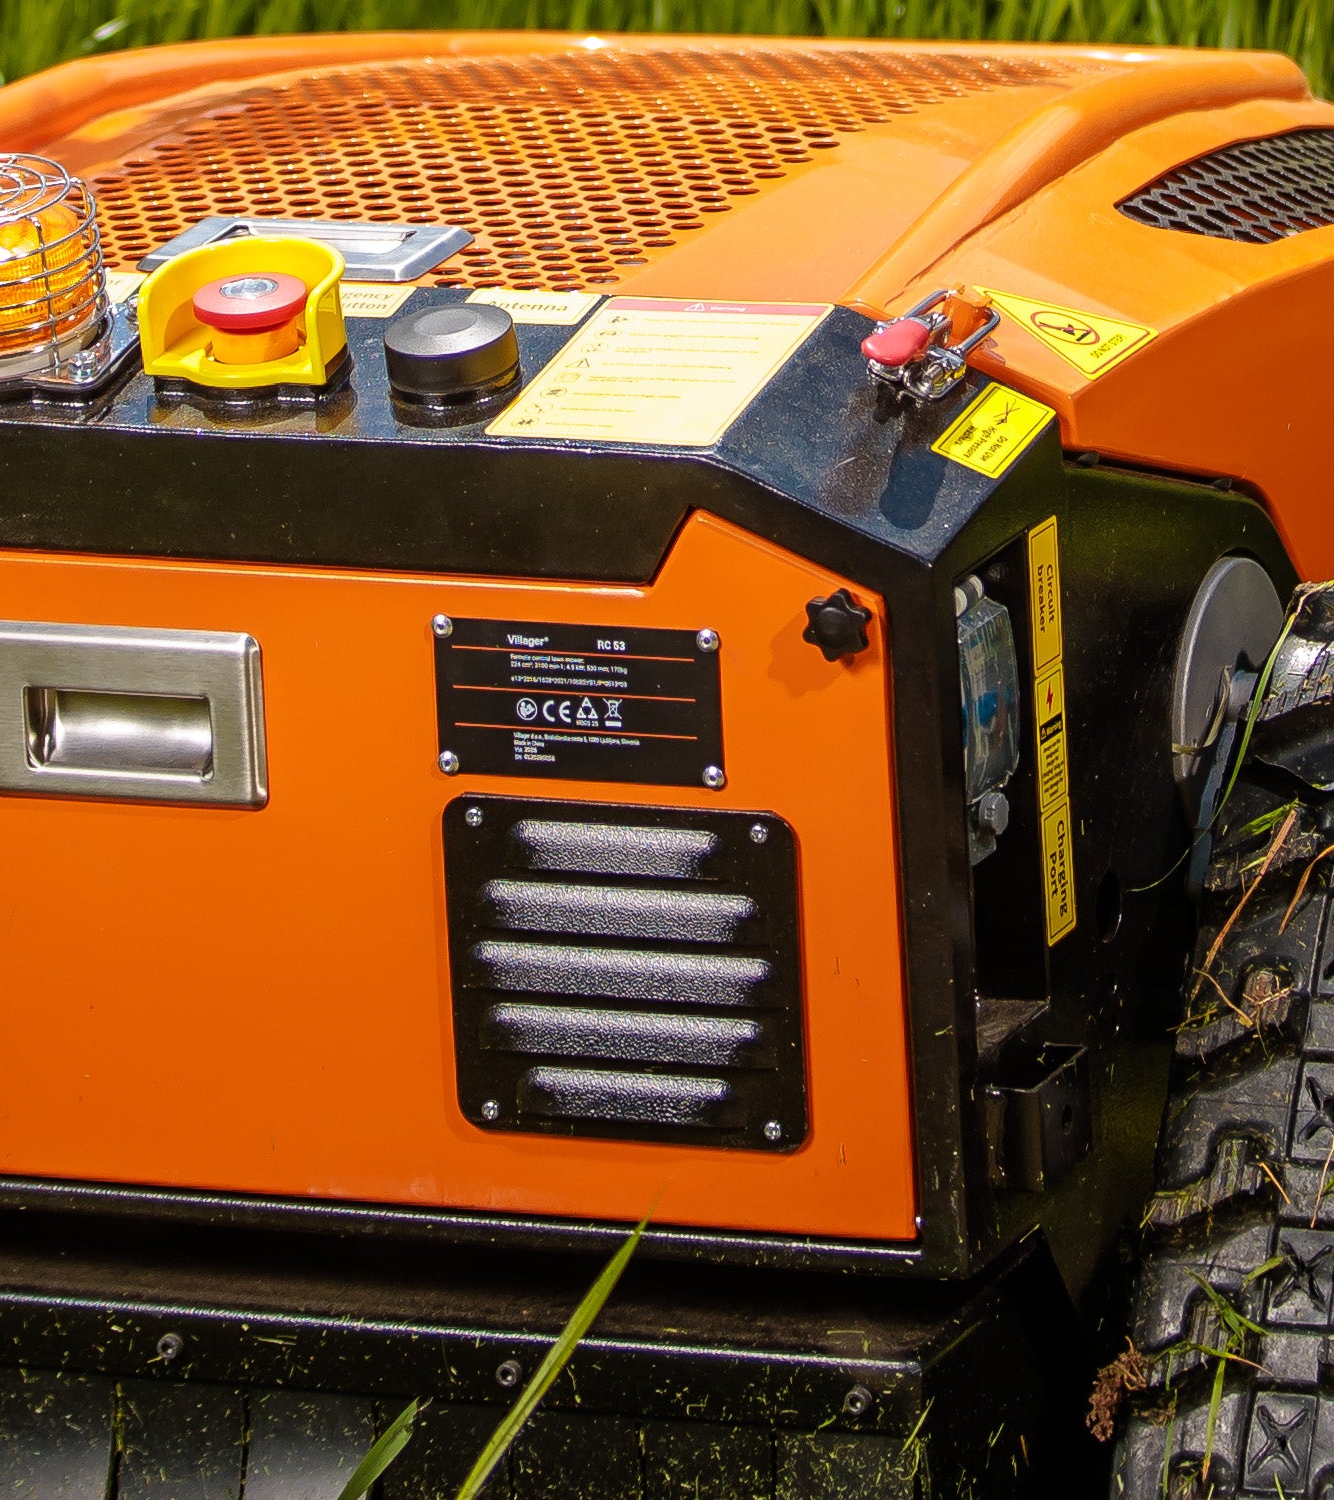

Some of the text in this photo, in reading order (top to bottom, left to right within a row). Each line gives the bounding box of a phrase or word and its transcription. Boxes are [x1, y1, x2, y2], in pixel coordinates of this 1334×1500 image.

[342, 302, 387, 310] utton
[1037, 563, 1046, 633] breaker
[1046, 563, 1056, 624] Circuit
[597, 639, 612, 651] RC
[613, 640, 626, 651] 53
[1049, 850, 1058, 899] Port
[1056, 819, 1069, 918] Charging
